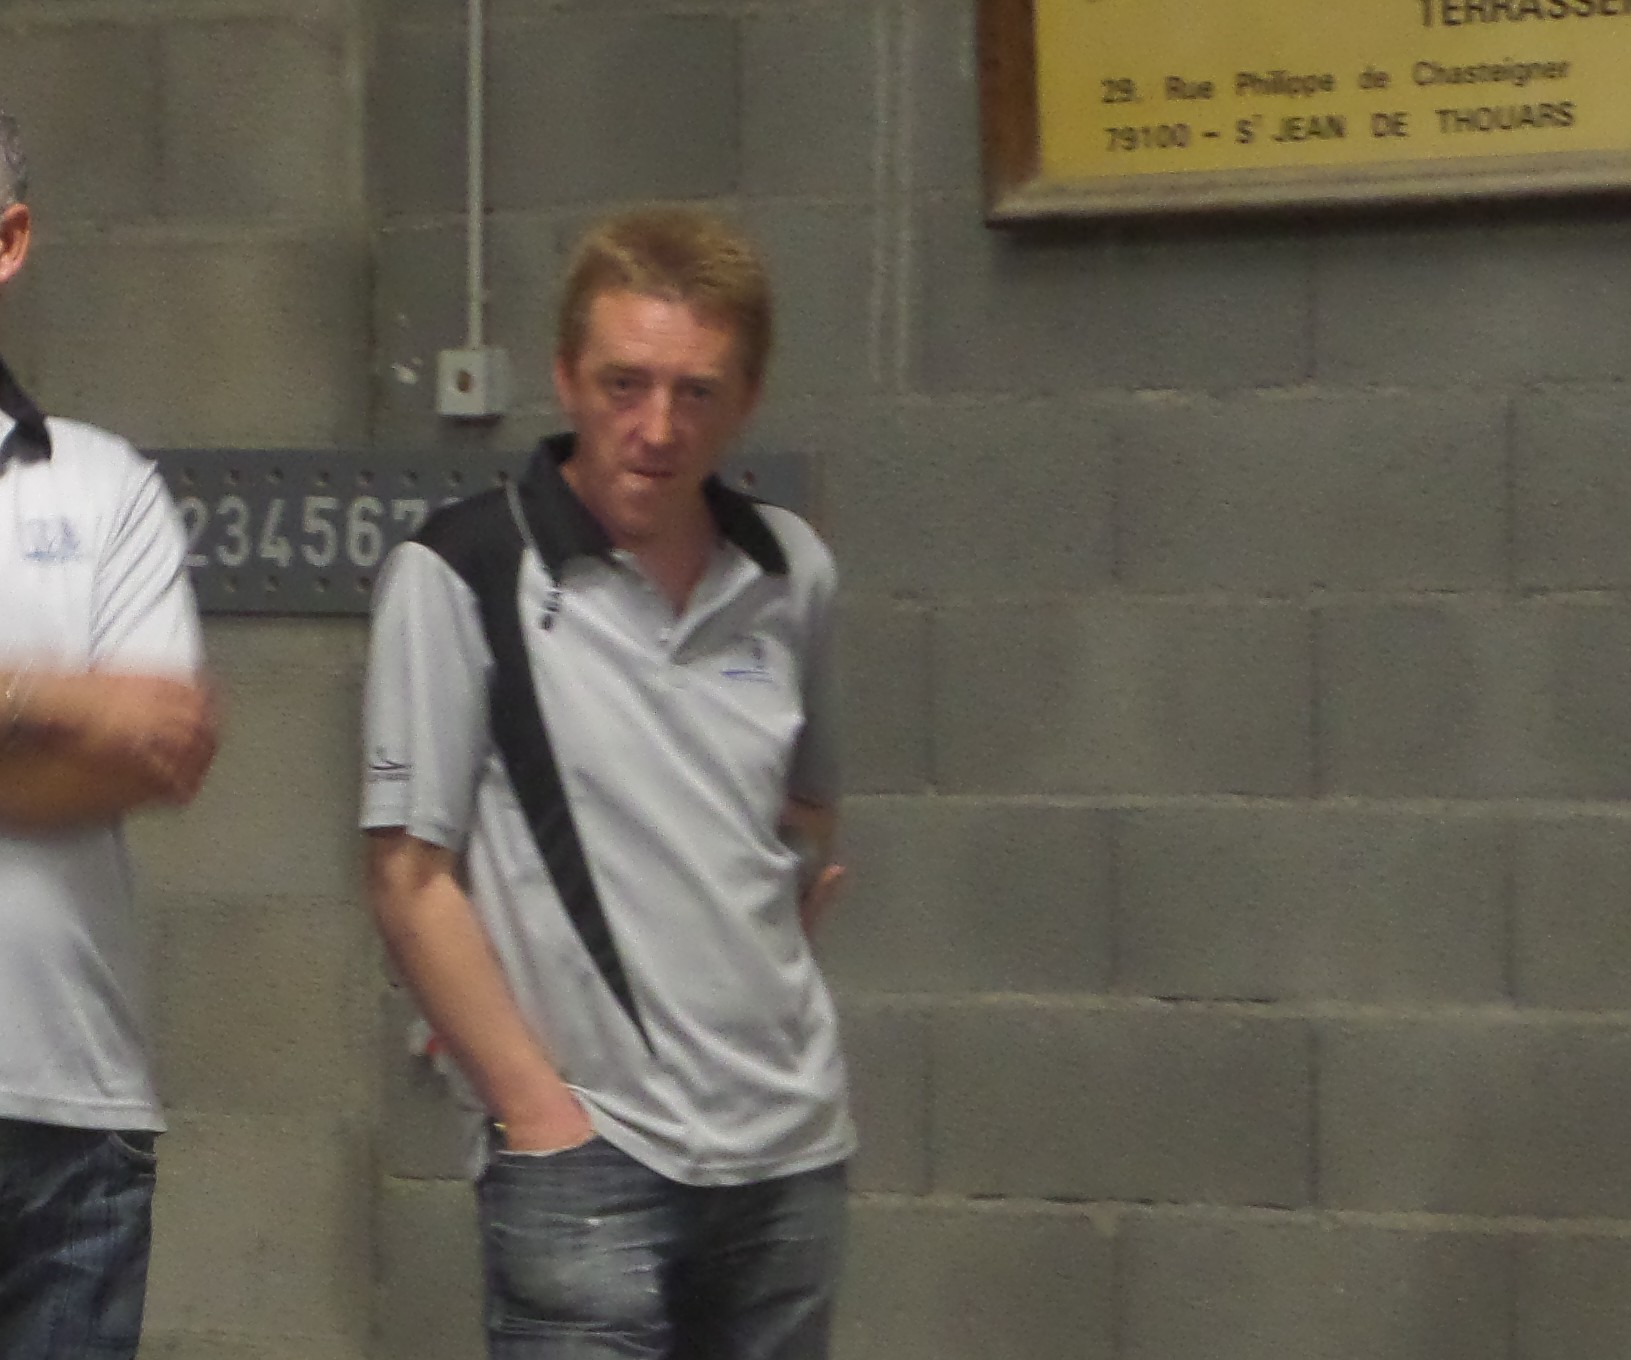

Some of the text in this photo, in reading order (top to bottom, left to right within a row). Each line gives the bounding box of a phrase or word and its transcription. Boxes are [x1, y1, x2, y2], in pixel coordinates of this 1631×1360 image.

[1418, 0, 1631, 28] TERRASSE
[1166, 75, 1214, 101] Rue
[1235, 69, 1336, 98] Philippe
[1357, 65, 1390, 90] de
[1412, 57, 1571, 88] Chasteigner
[1104, 122, 1191, 152] 79100
[1272, 115, 1346, 143] JEAN
[1370, 111, 1410, 138] DE
[1434, 101, 1577, 134] THOUARS
